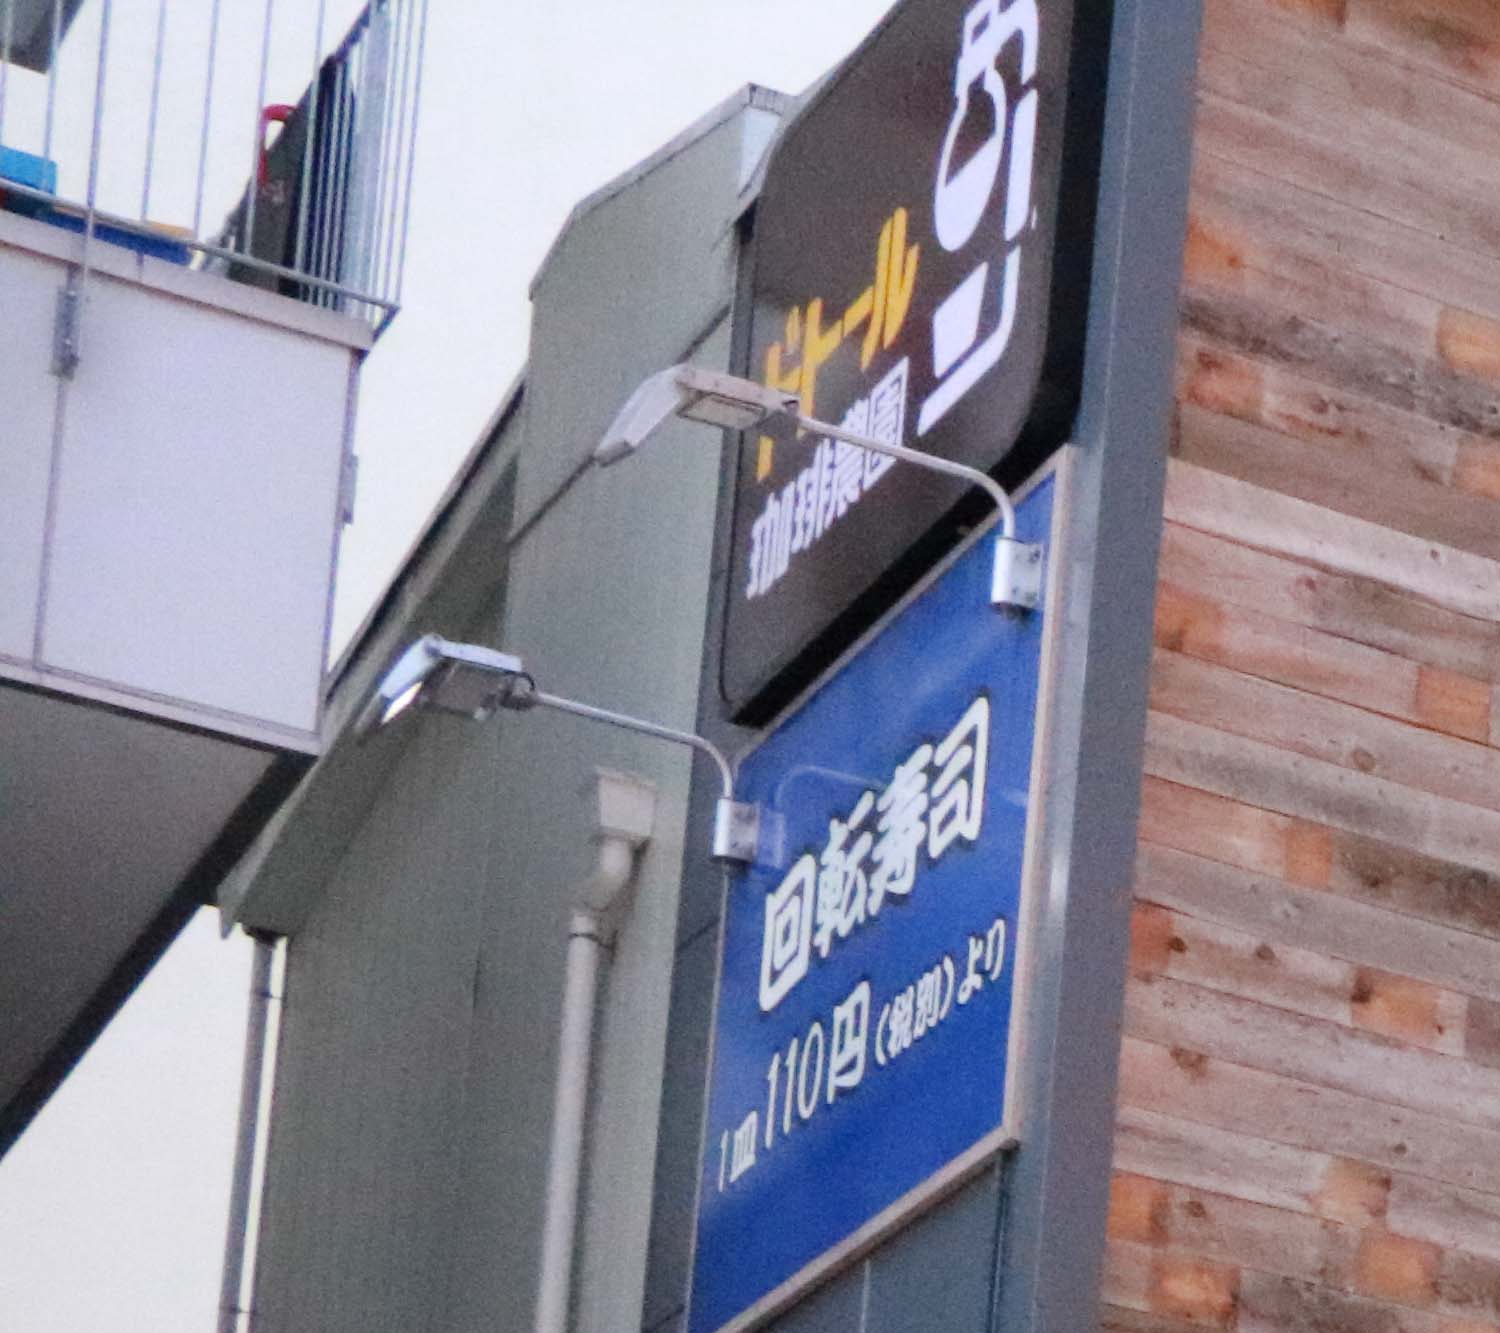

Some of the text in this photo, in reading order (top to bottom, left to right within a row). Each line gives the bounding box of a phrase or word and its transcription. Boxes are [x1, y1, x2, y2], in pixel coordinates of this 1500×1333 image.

[745, 355, 911, 600] 珈琲農園
[755, 207, 920, 482] ドトール
[757, 695, 992, 1015] 回転寿司
